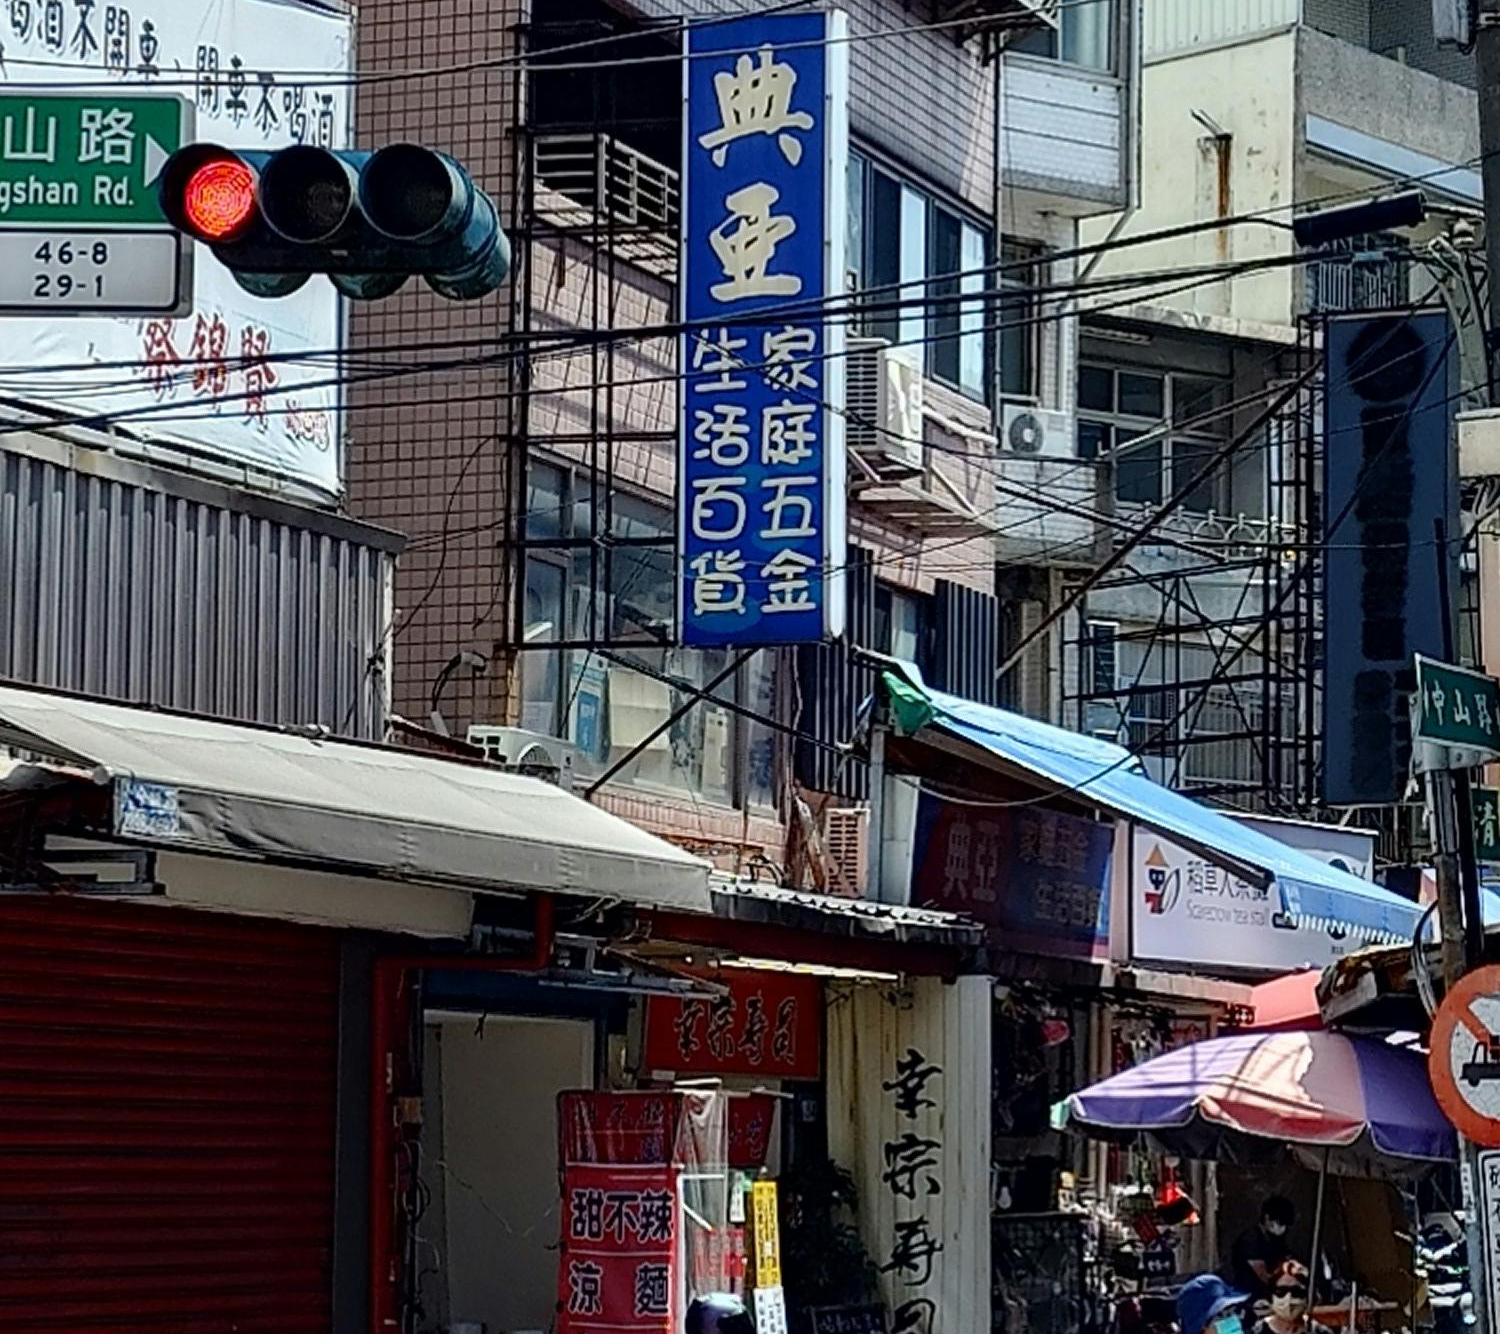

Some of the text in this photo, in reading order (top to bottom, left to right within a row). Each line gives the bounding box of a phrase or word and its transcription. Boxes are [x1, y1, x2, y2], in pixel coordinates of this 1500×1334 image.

[4, 107, 136, 164] 山路
[94, 176, 134, 205] Rd.
[699, 45, 814, 300] 典亞
[35, 242, 108, 265] 46-8
[34, 275, 103, 298] 29-1
[690, 329, 750, 615] 生活百貨
[760, 326, 816, 612] 家庭五金
[569, 1189, 675, 1243] 甜不辣
[567, 1261, 671, 1316] 涼麵
